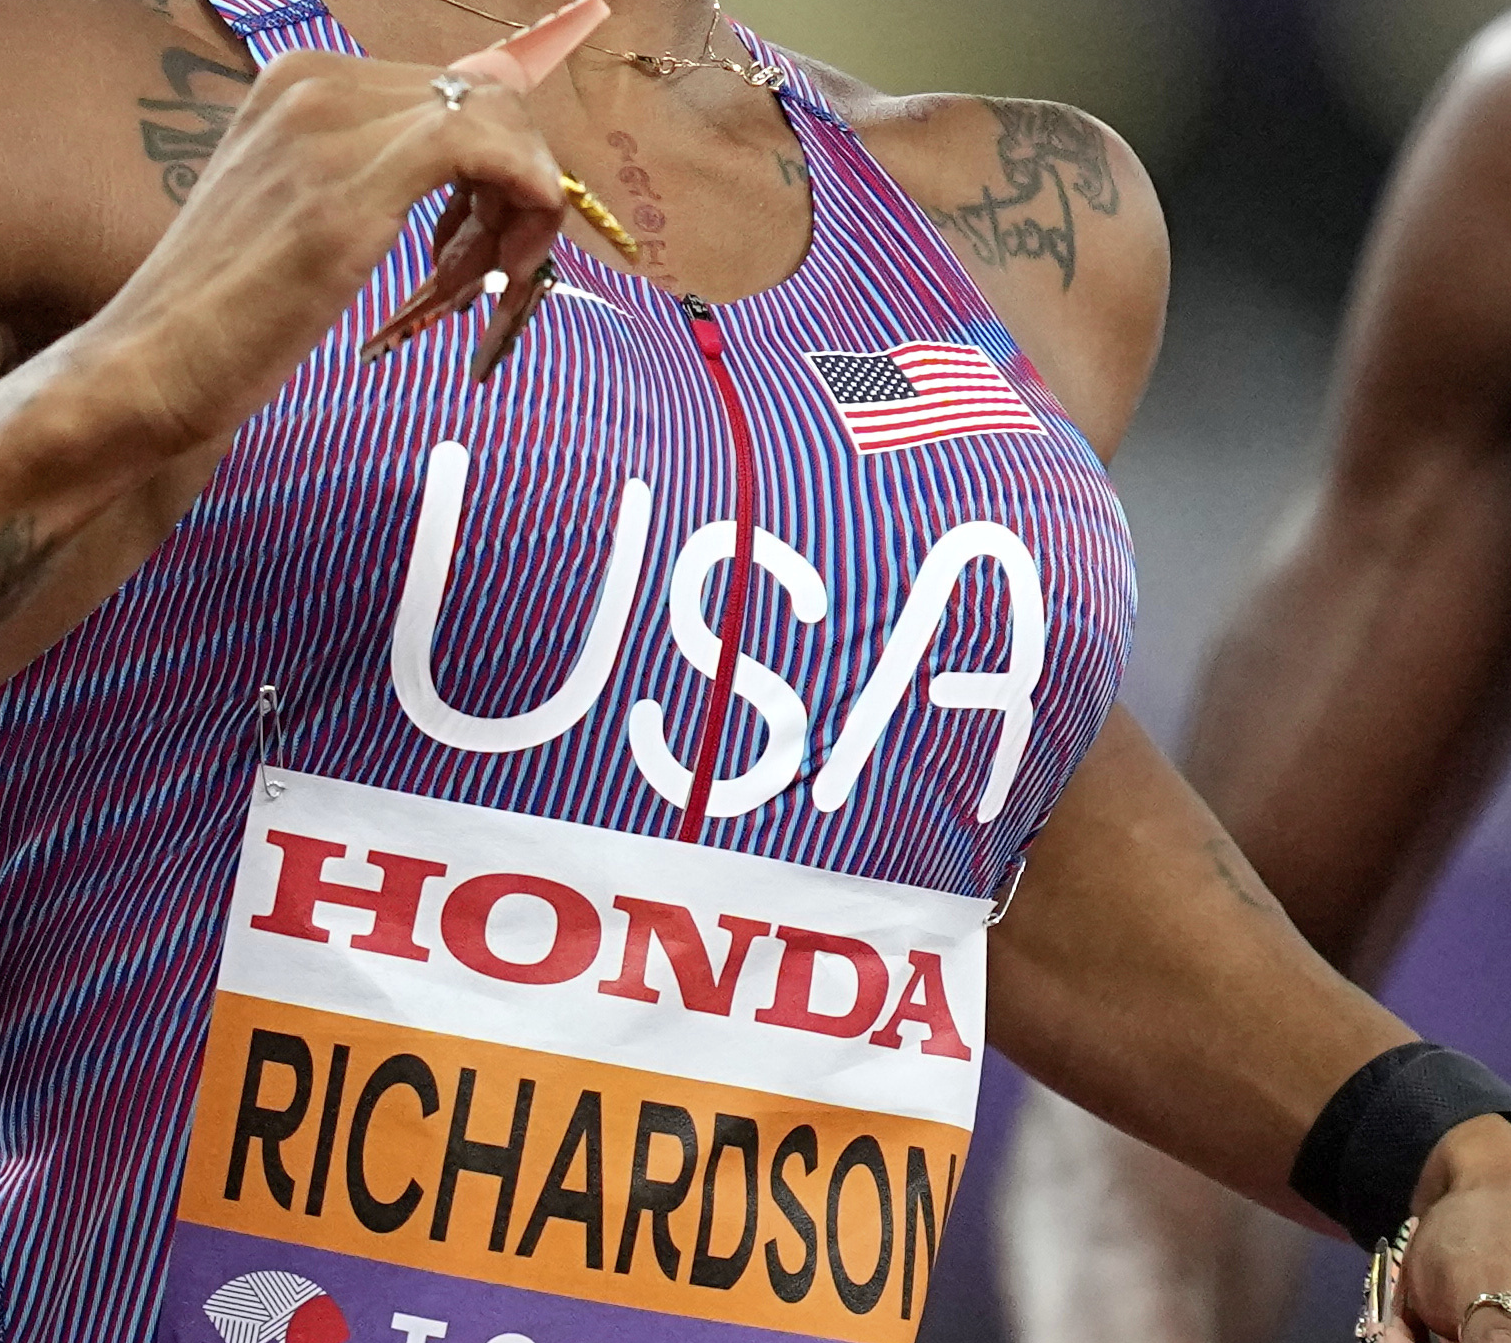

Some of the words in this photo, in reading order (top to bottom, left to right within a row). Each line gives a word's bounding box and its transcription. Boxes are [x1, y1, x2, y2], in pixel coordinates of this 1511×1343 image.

[392, 439, 1046, 824] USA
[250, 829, 972, 1062] HONDA
[224, 1028, 957, 1321] RICHARDSON
